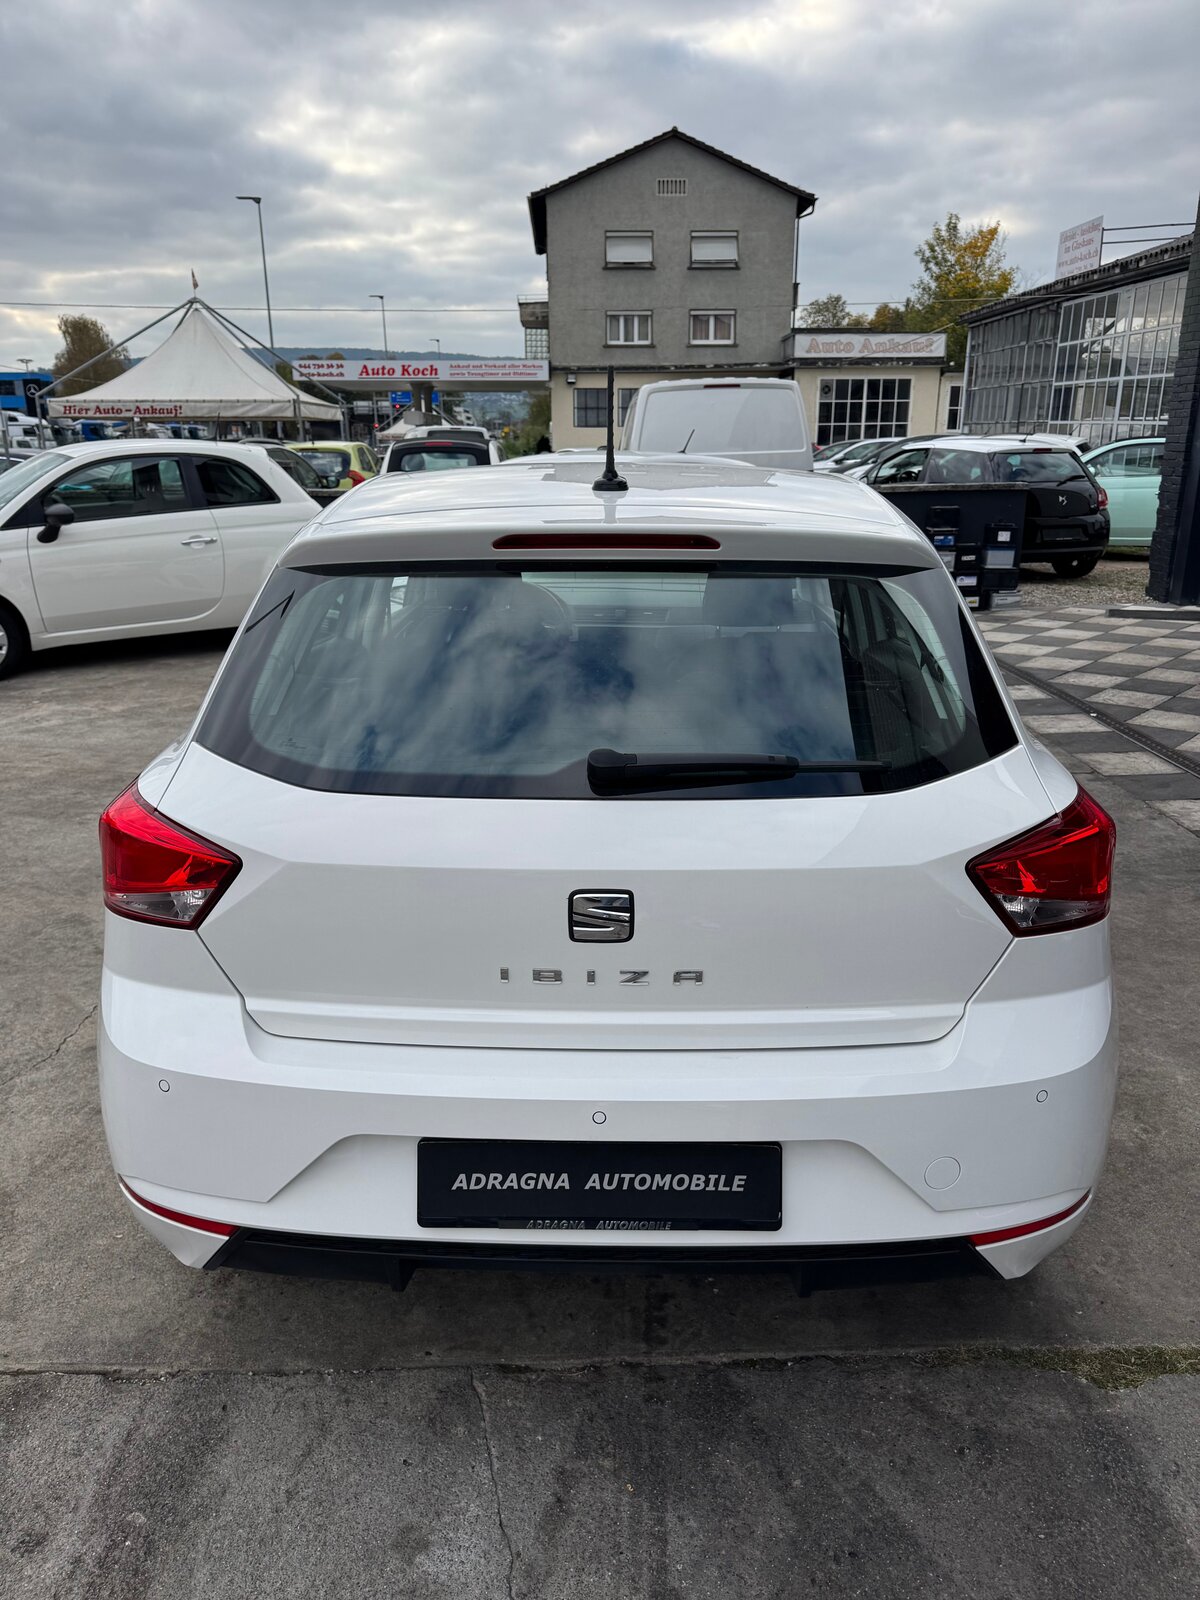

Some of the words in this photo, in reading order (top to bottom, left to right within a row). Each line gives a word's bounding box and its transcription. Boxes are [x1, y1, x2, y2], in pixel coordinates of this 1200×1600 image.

[806, 338, 854, 353] Auto
[858, 338, 935, 353] Ankauf
[358, 364, 395, 377] Auto
[401, 364, 439, 377] Koch
[63, 405, 90, 415] Hier
[500, 967, 704, 986] IBIZA
[451, 1172, 570, 1191] ADRAGNA
[584, 1172, 747, 1193] AUTOMOBILE
[526, 1219, 586, 1230] ADRAGNA
[595, 1220, 672, 1231] AUTOMOBILE
